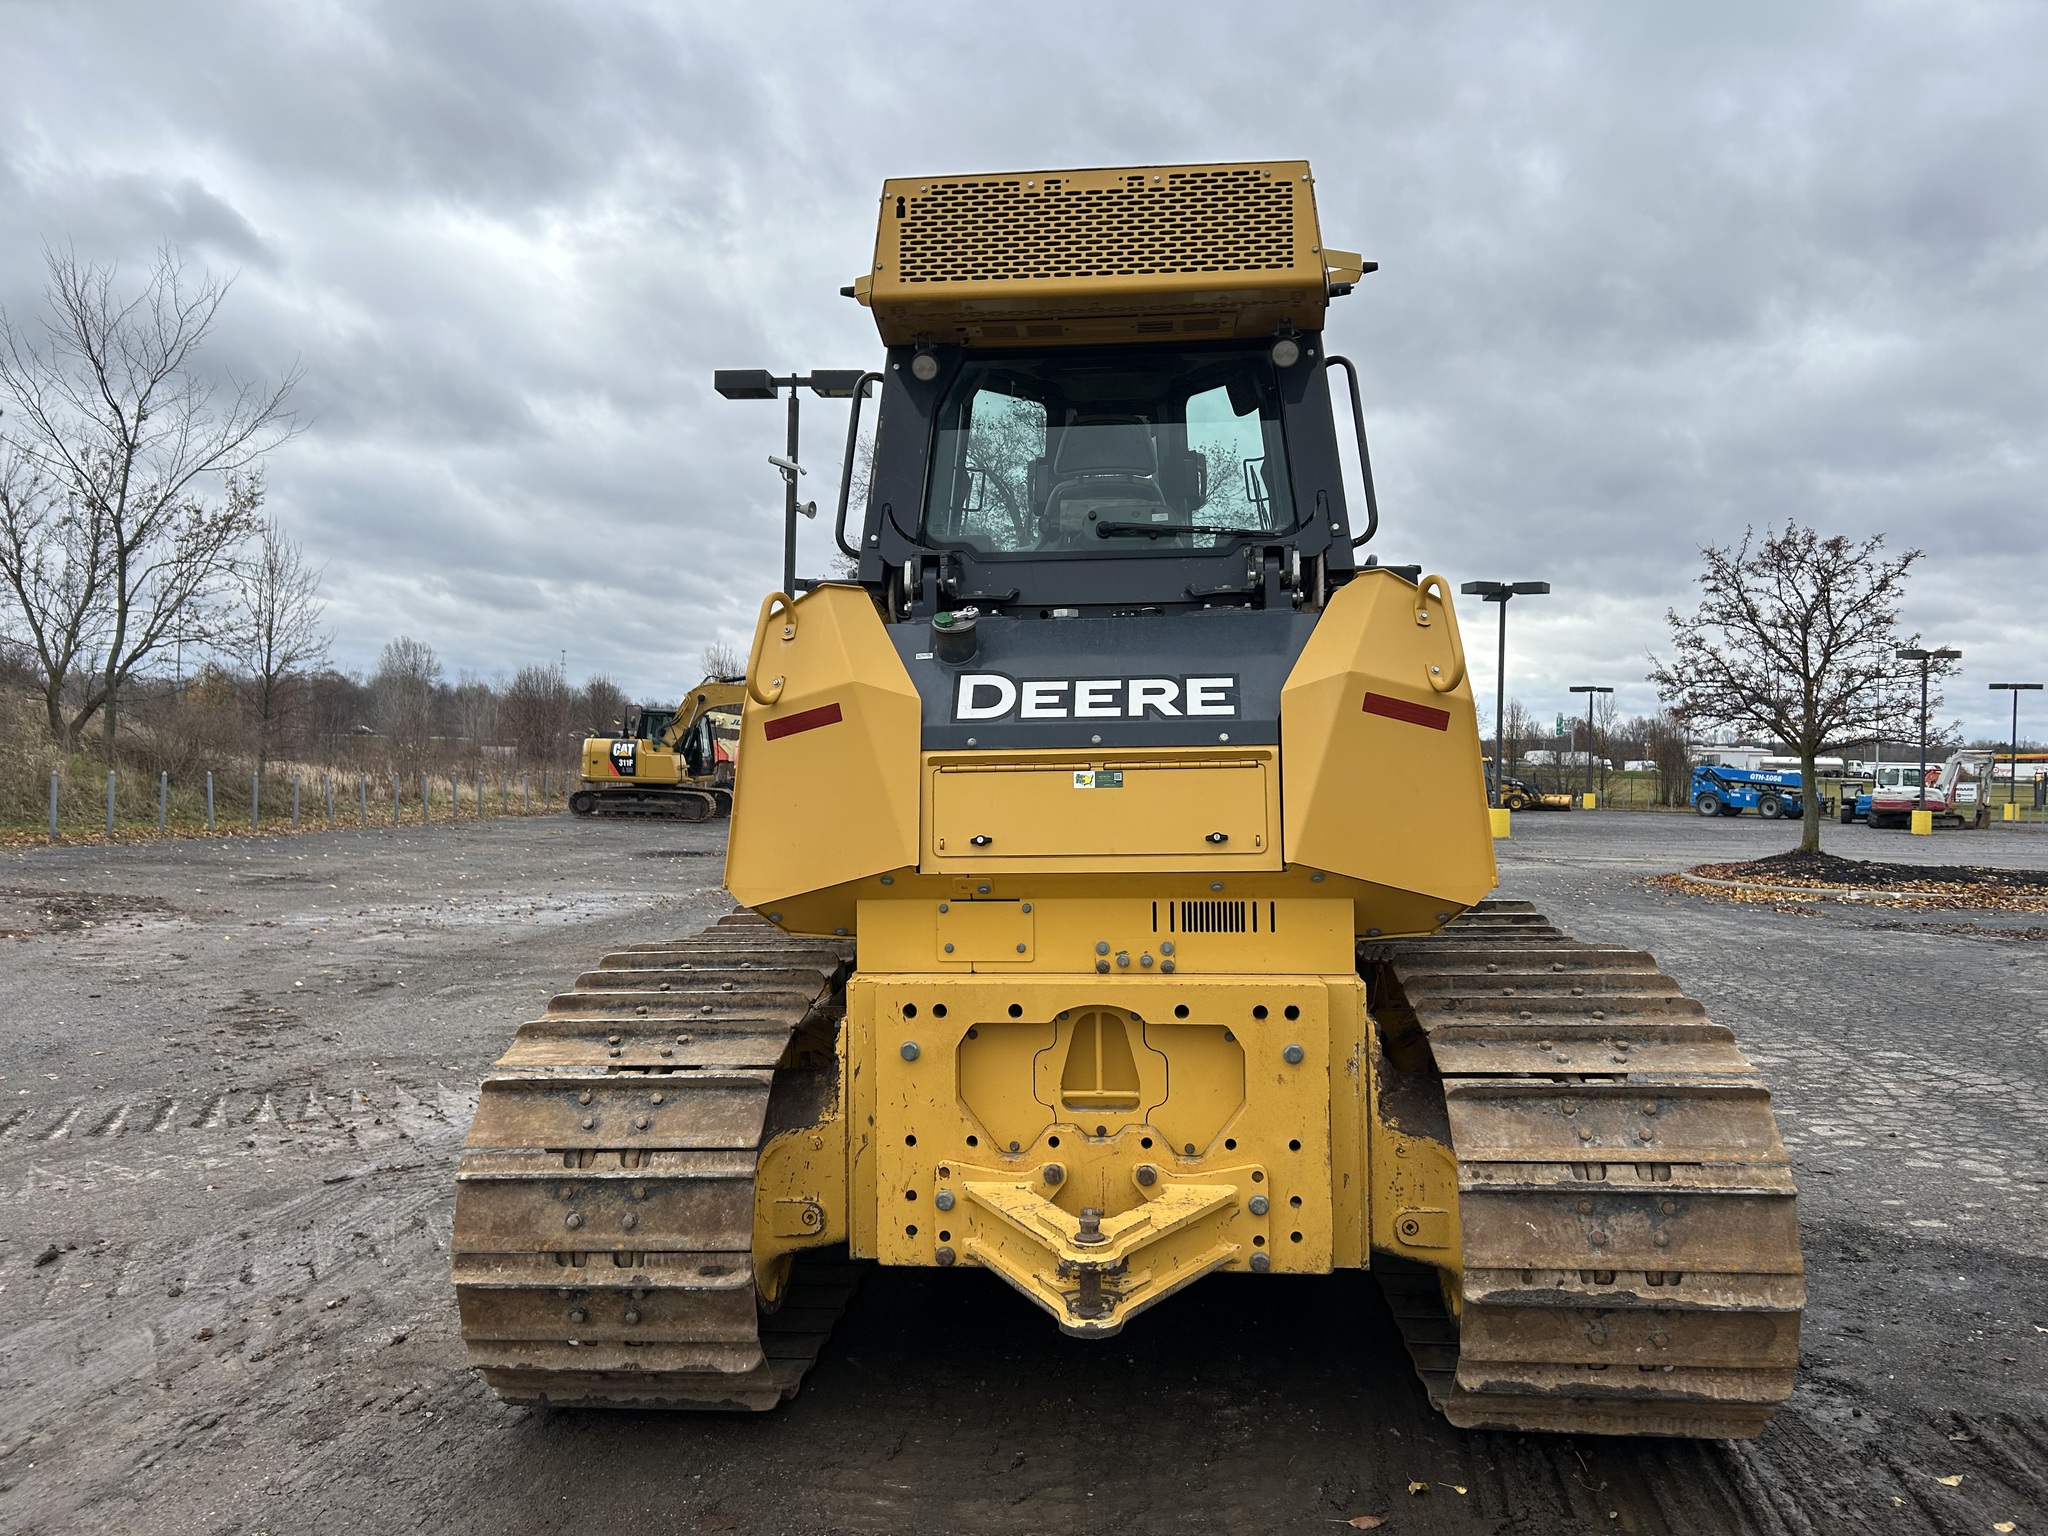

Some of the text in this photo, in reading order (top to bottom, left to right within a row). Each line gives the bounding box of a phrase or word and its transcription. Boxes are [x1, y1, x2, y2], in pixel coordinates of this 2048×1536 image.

[956, 674, 1235, 720] DEERE
[613, 743, 635, 757] CAT
[618, 759, 634, 767] 311F
